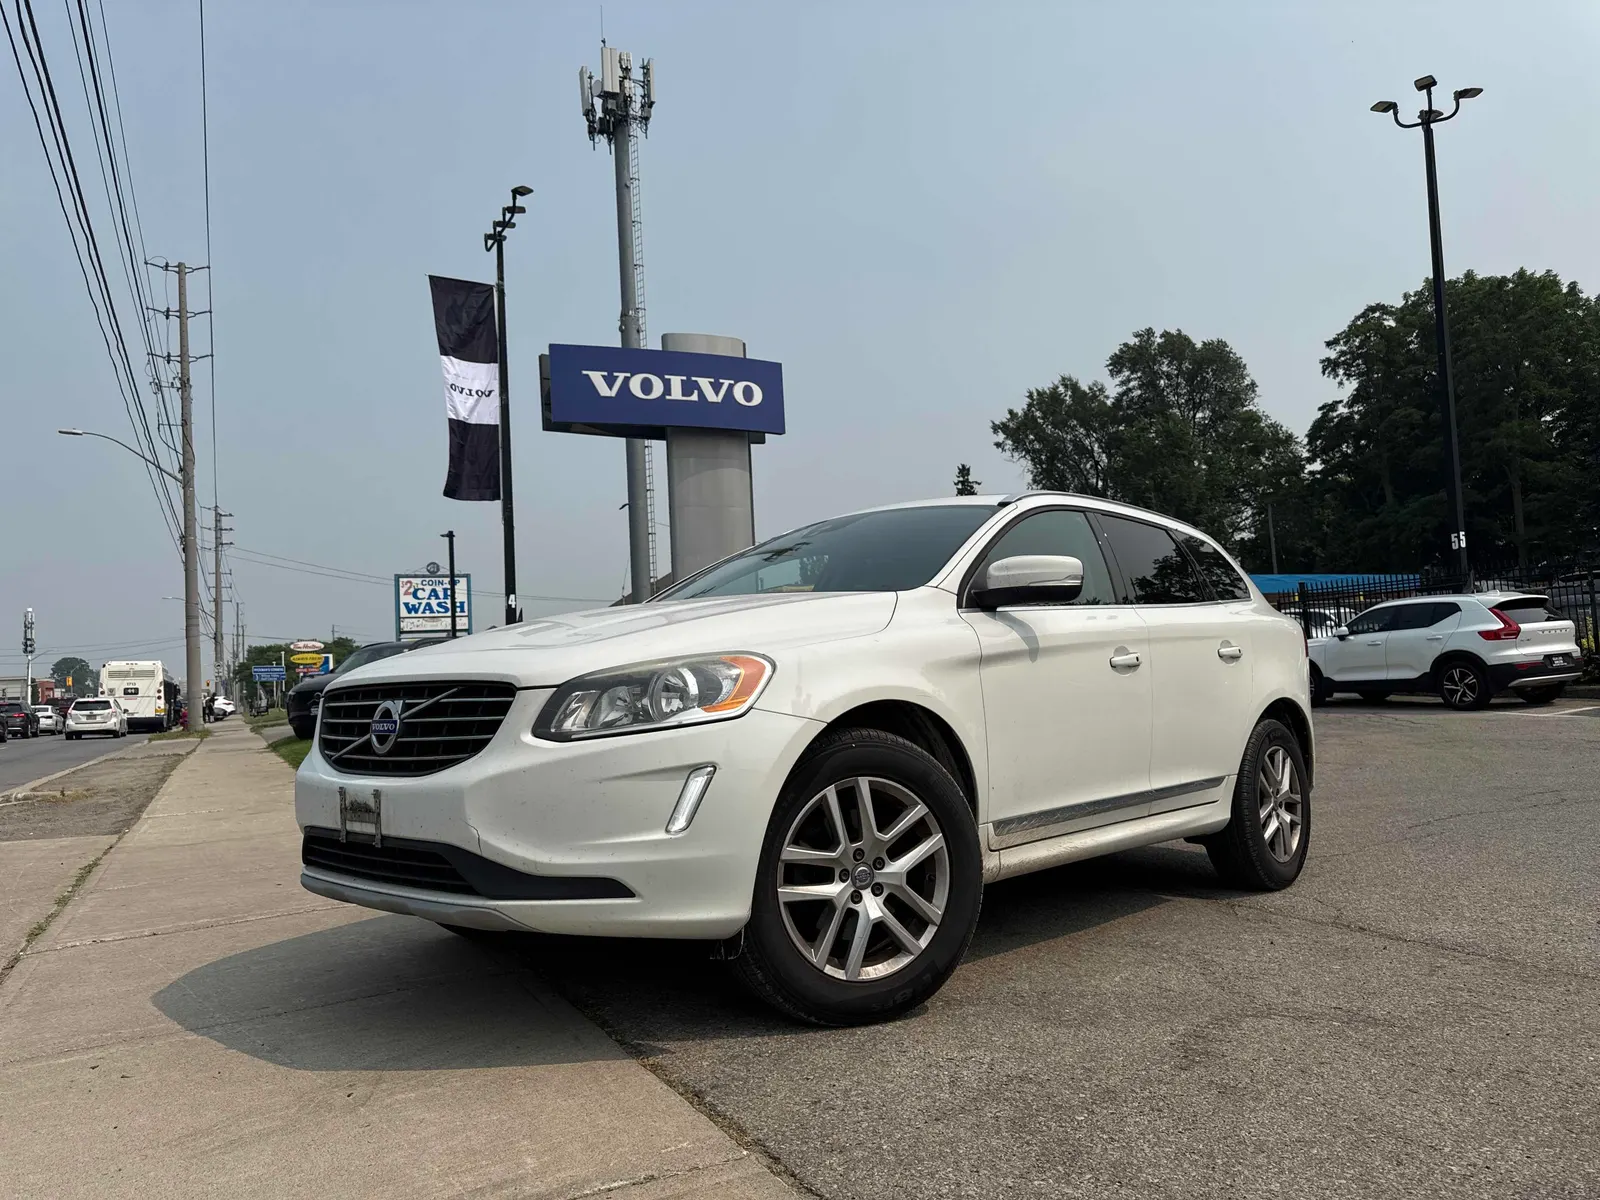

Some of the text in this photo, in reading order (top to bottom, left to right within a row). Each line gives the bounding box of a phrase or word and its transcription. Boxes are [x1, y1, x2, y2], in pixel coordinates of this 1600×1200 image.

[581, 370, 763, 407] VOLVO
[402, 601, 466, 615] WASH
[508, 594, 516, 608] 4
[372, 723, 396, 731] VOLVO
